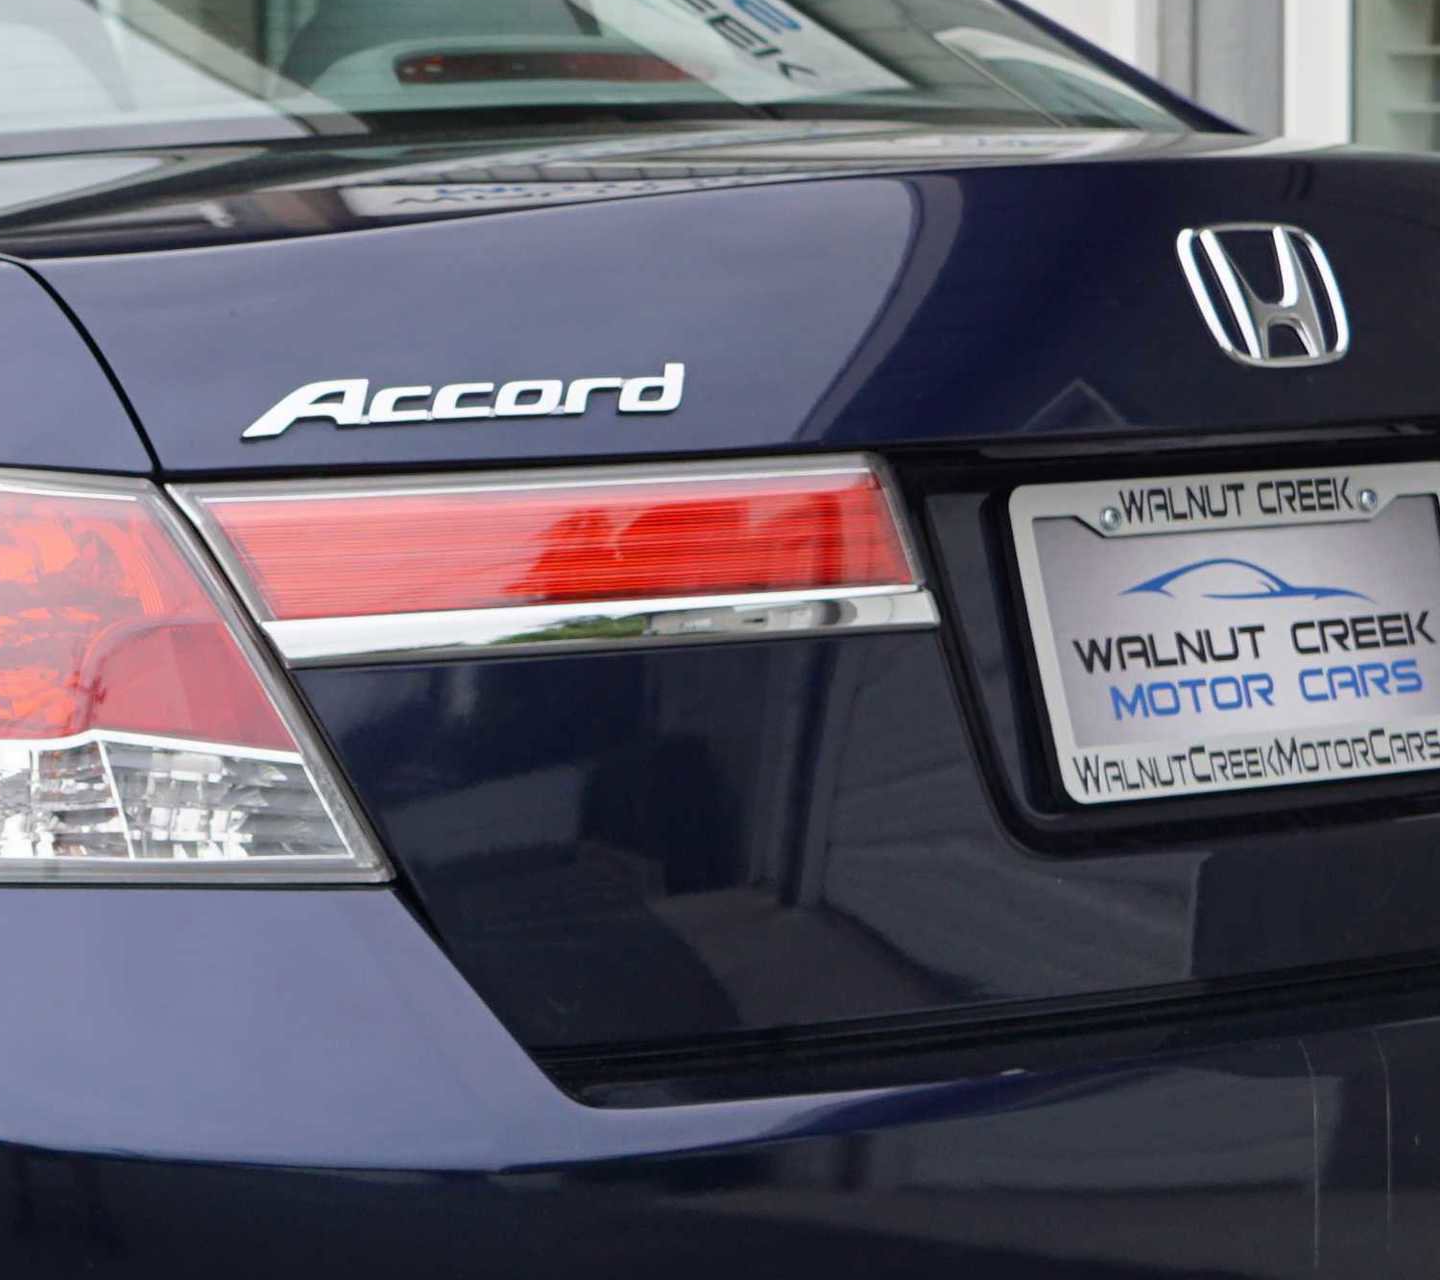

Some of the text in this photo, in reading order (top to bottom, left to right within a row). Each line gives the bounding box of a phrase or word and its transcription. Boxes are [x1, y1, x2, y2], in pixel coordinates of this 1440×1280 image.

[241, 362, 685, 440] Accord
[1119, 476, 1354, 523] WALNUT CREEK
[1072, 610, 1436, 675] WALNUT CREEK
[1110, 658, 1425, 721] MOTOR CARS
